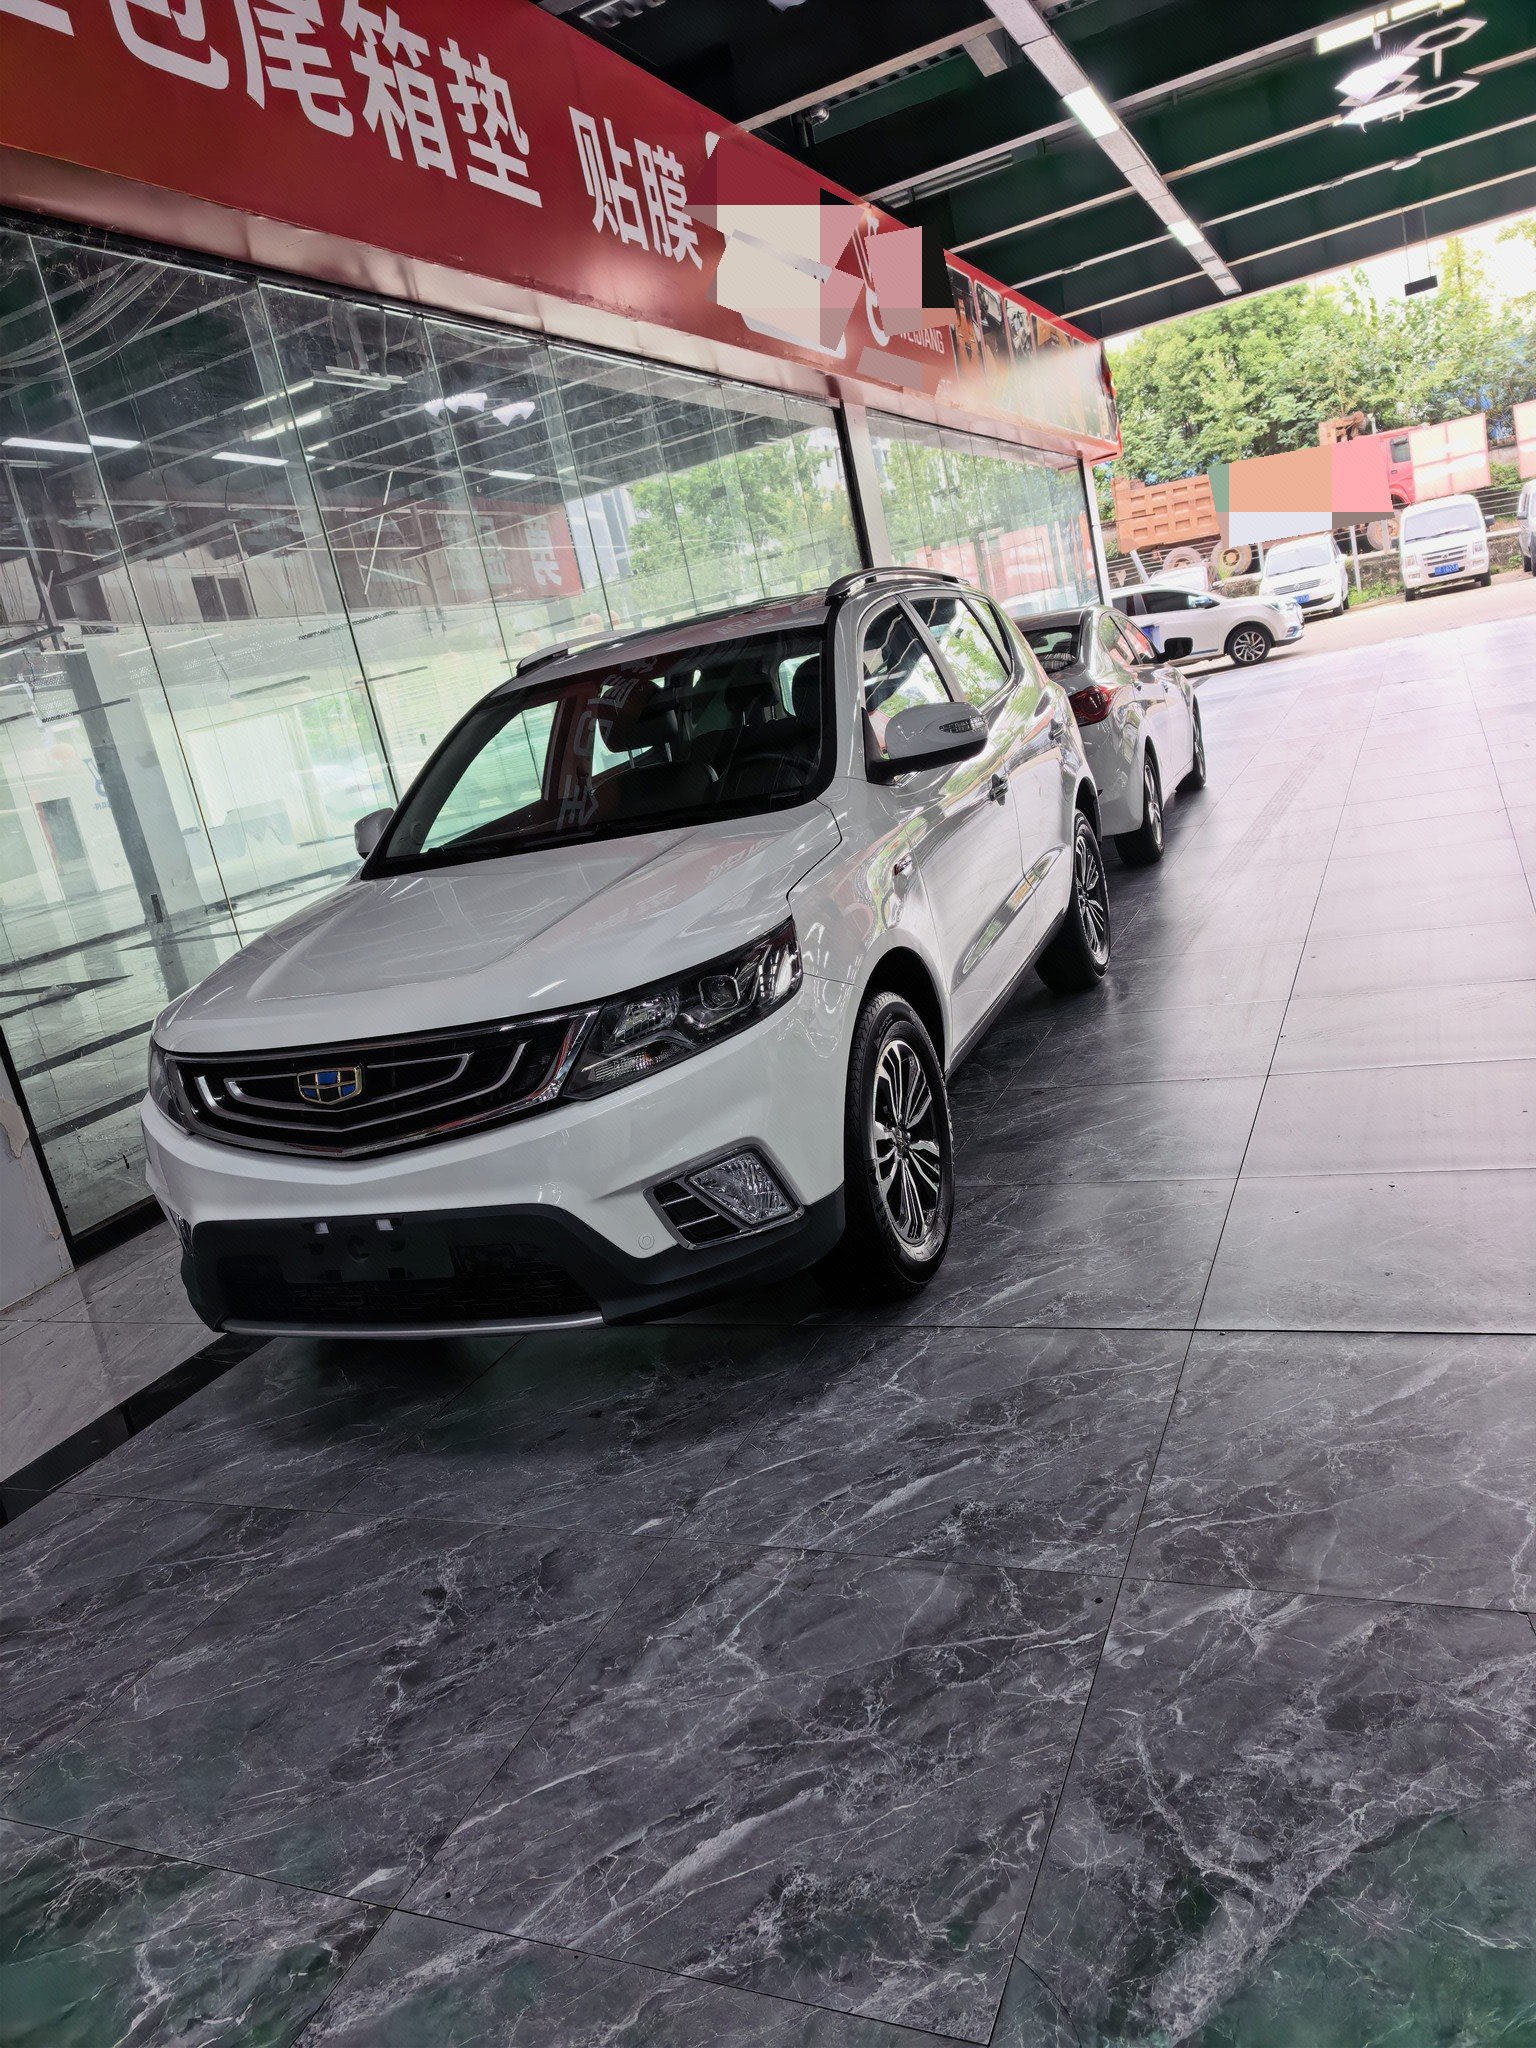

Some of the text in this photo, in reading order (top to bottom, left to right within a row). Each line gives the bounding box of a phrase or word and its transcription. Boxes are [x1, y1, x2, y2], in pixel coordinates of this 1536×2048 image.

[0, 0, 543, 208] 尾箱垫
[568, 105, 704, 272] 贴膜
